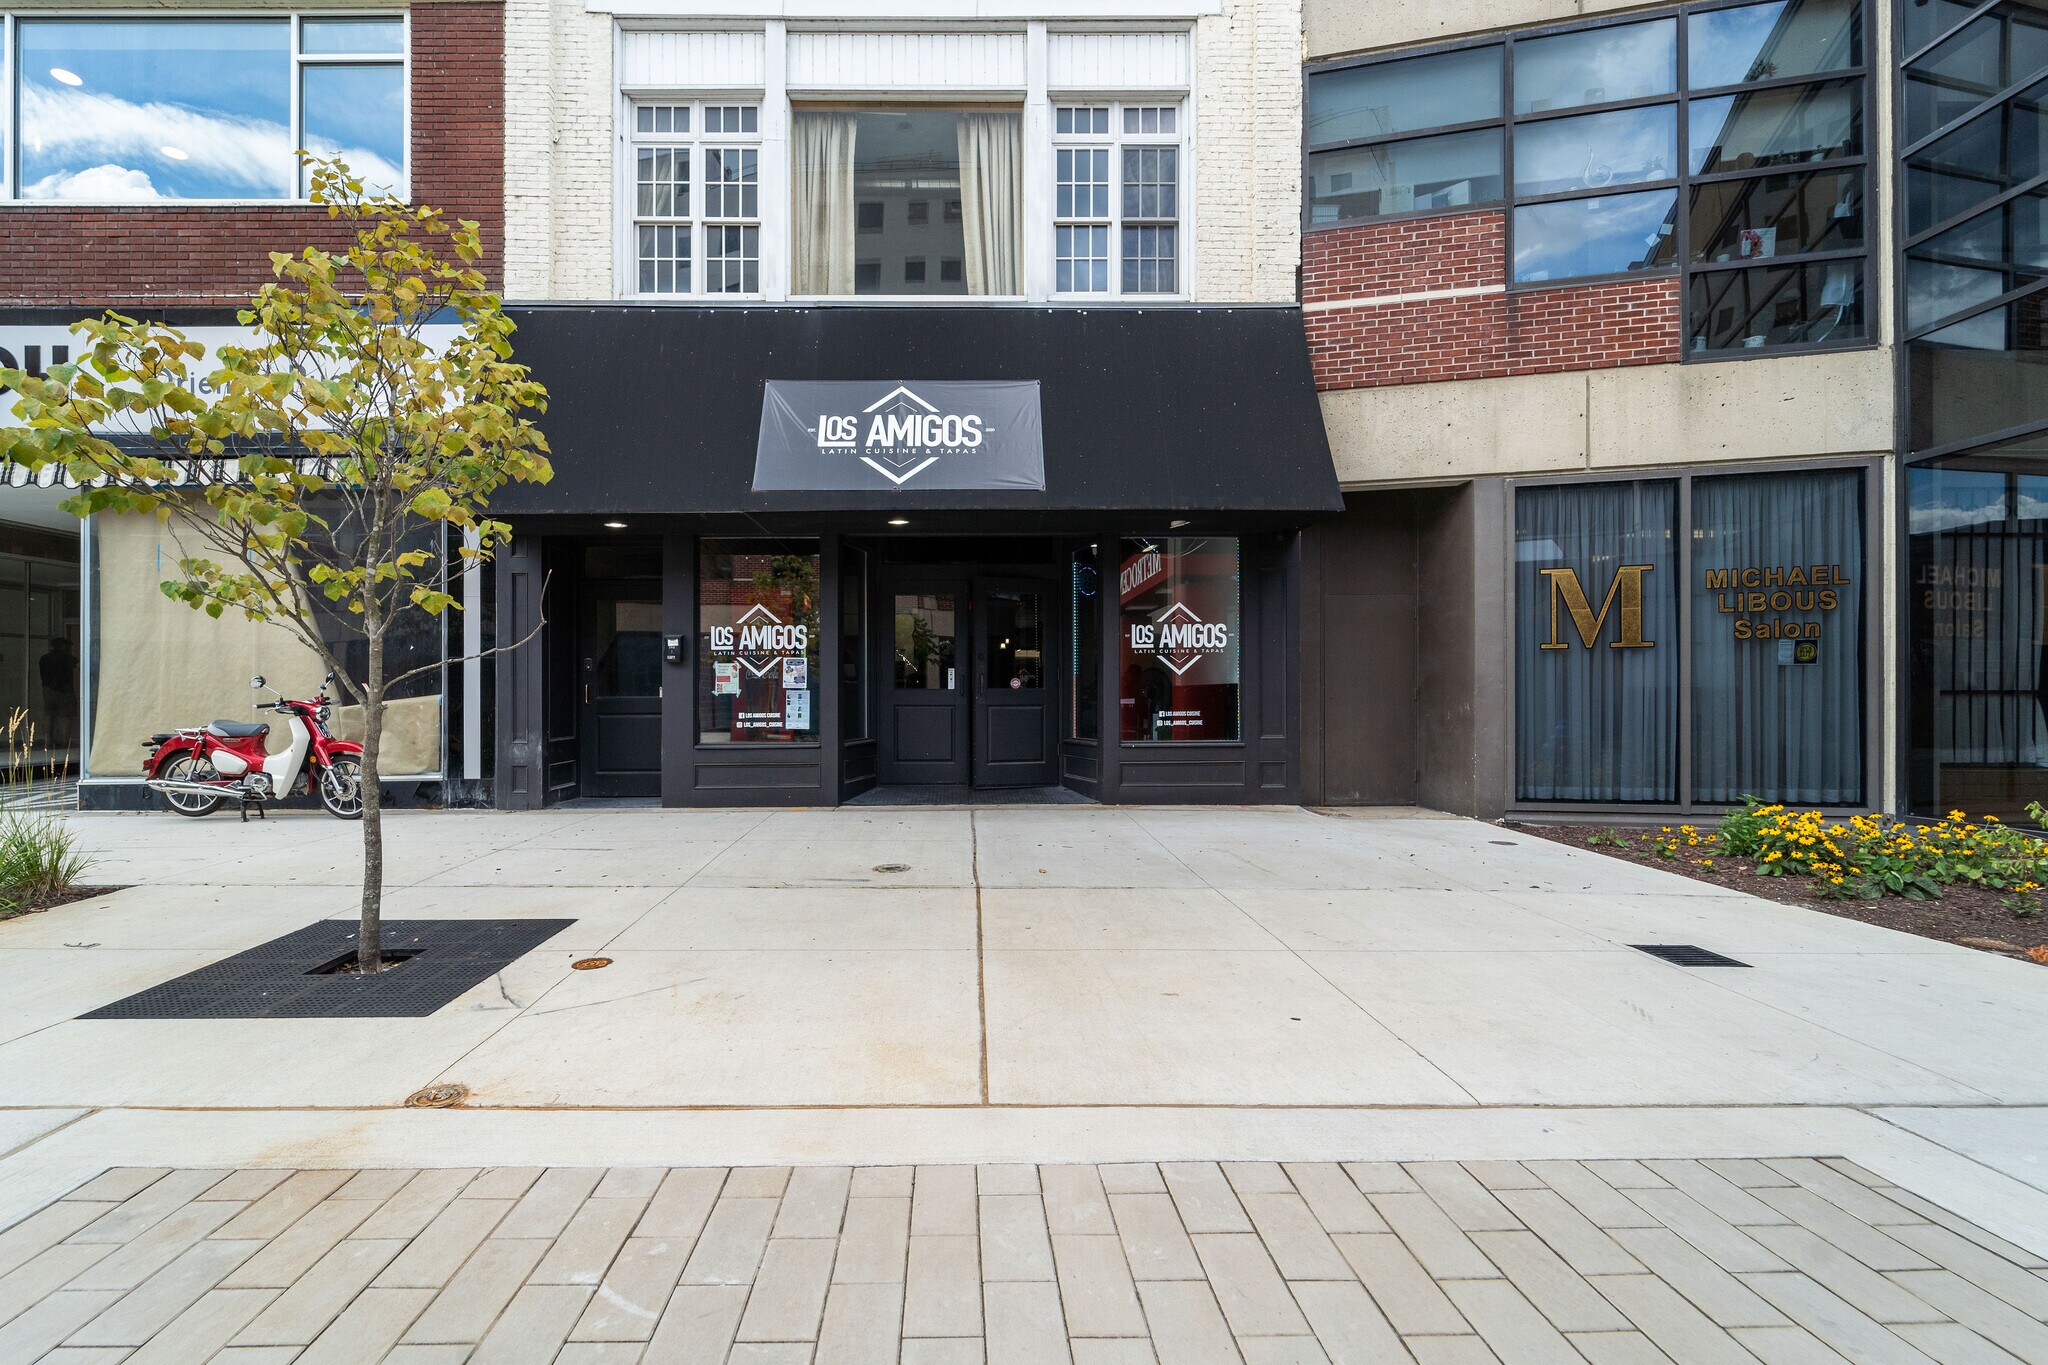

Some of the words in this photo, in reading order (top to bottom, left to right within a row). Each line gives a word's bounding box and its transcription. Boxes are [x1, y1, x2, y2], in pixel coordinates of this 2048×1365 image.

[817, 414, 858, 447] LOS
[865, 414, 983, 448] AMIGOS
[1705, 564, 1851, 589] MICHAEL
[1539, 564, 1655, 650] M
[1717, 589, 1838, 613] LIBOUS
[710, 625, 734, 651] LOS
[738, 624, 808, 650] AMIGOS
[1131, 623, 1155, 649] LOS
[1159, 623, 1228, 648] AMIGOS
[1734, 618, 1822, 640] Salon
